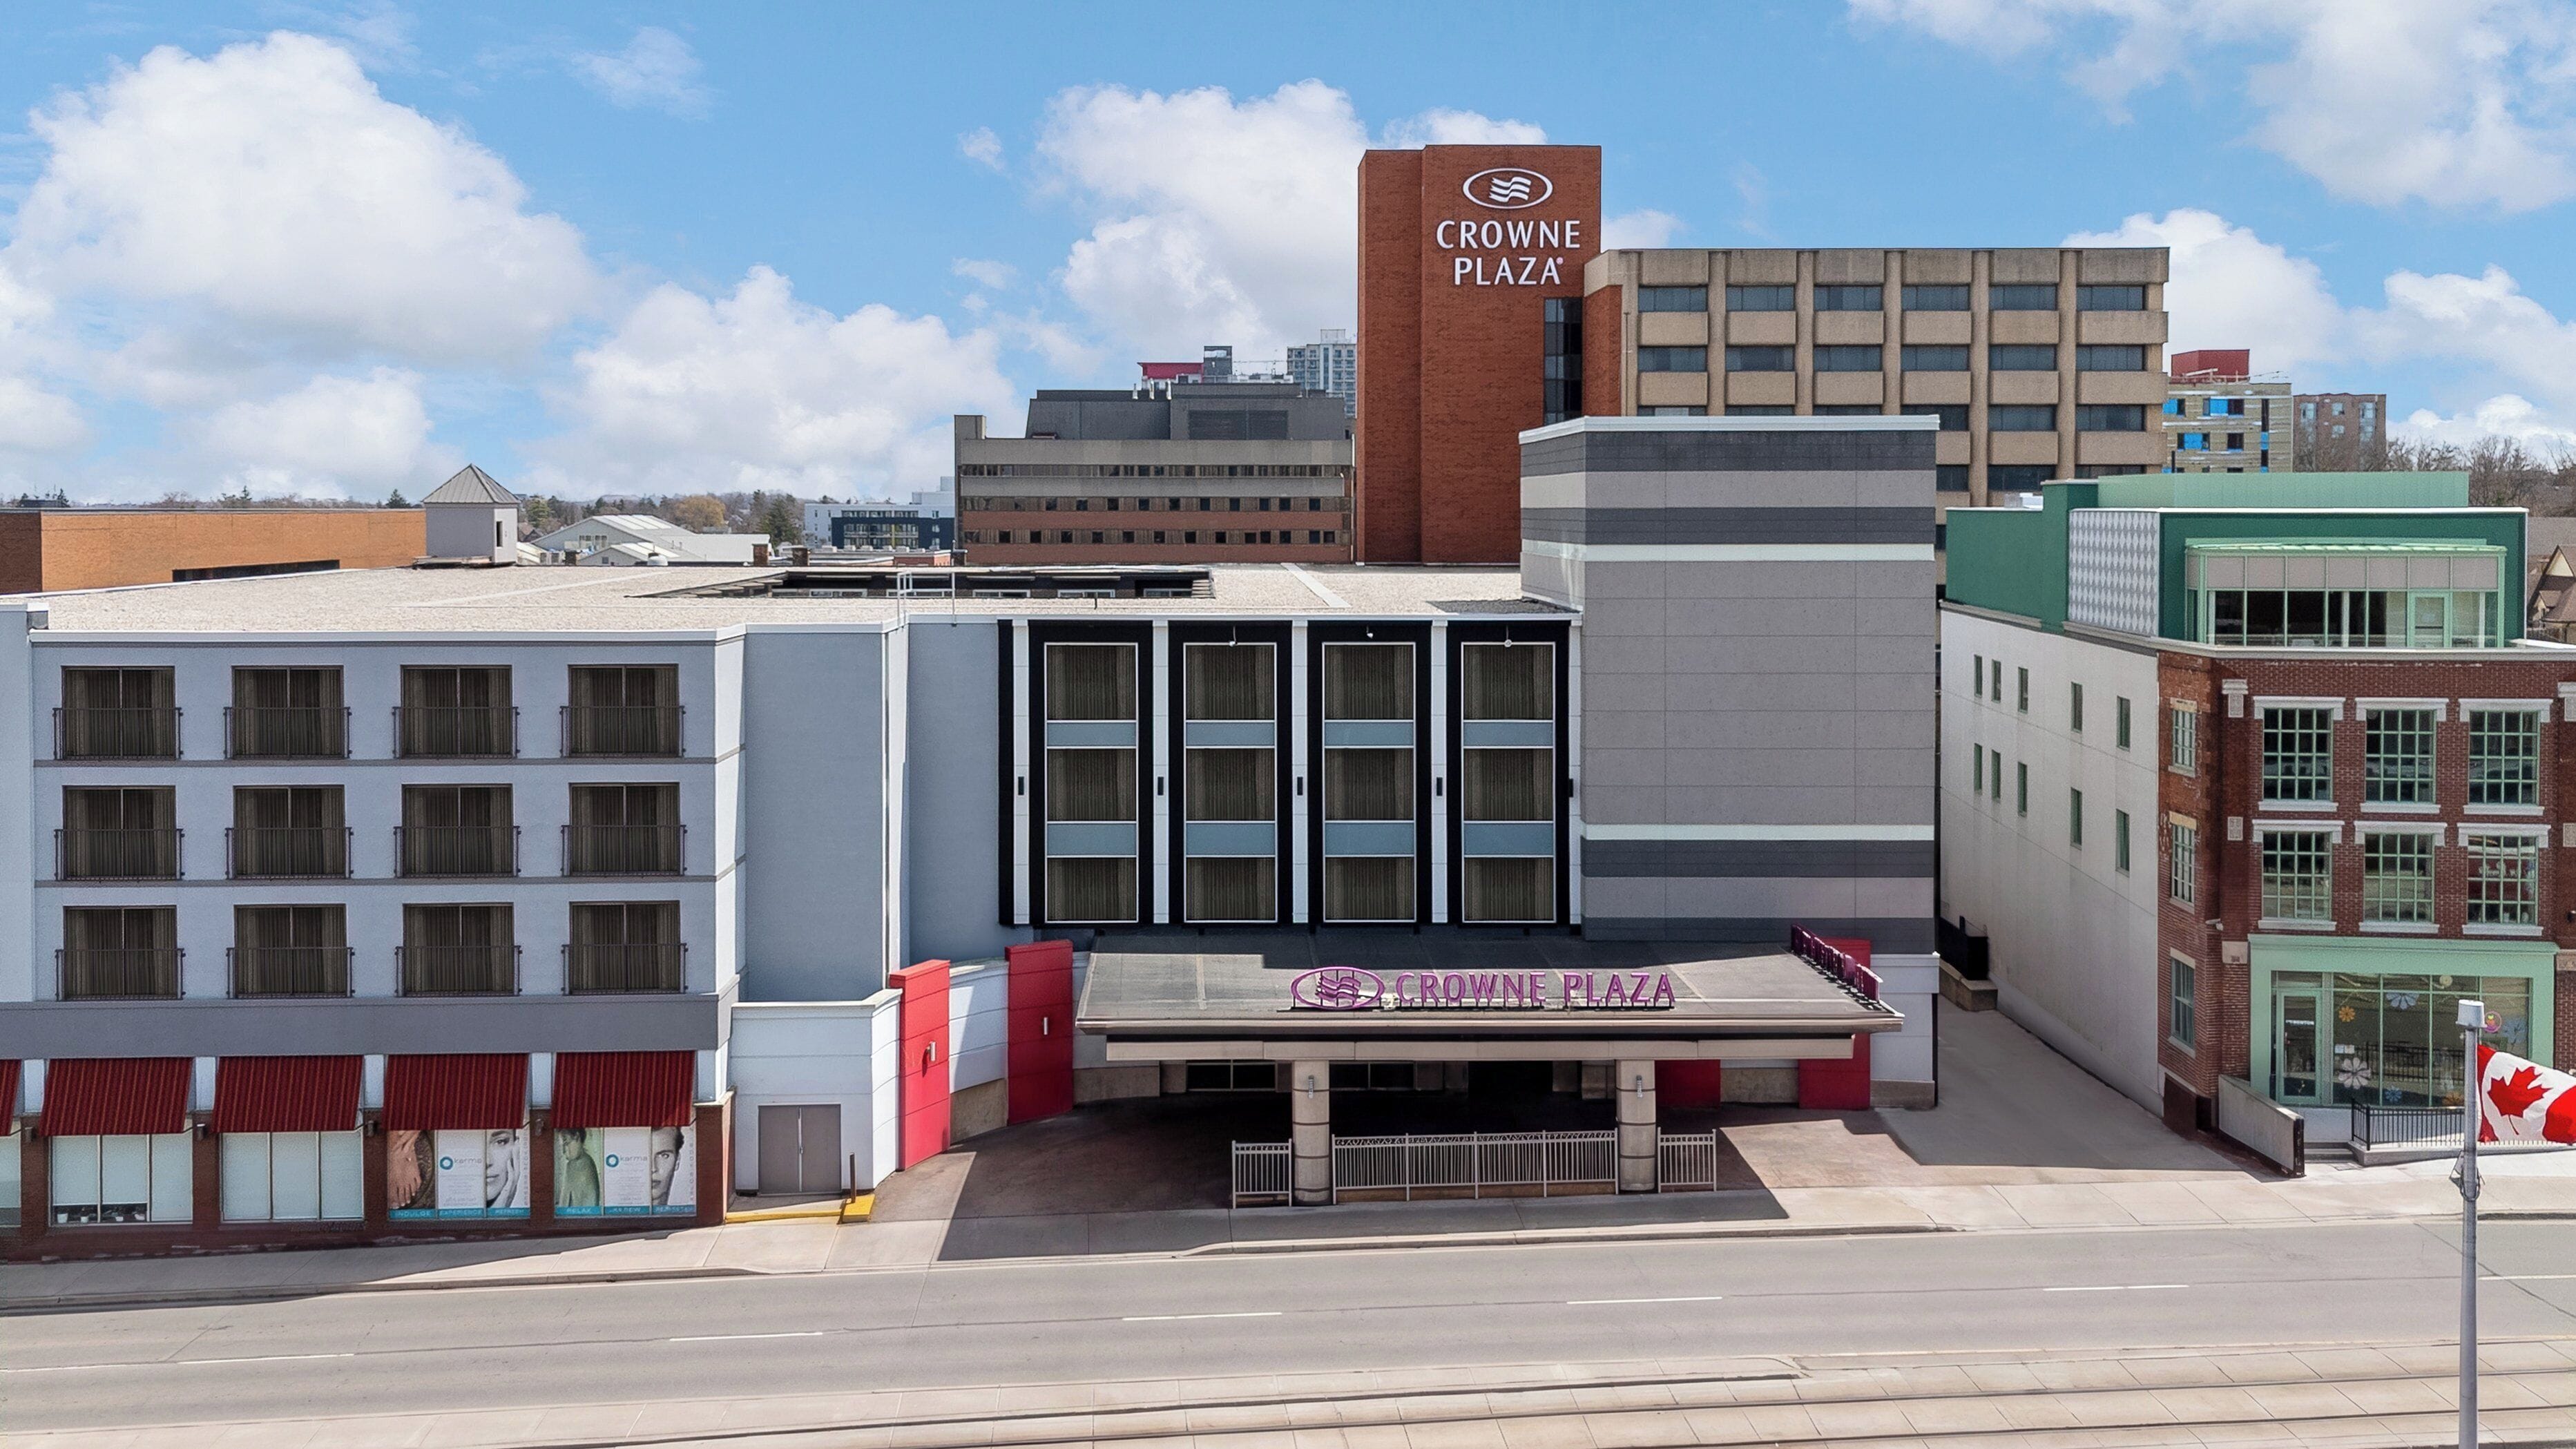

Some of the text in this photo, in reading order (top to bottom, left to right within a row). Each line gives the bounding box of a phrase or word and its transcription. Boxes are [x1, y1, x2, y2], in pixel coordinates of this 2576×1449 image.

[1436, 220, 1581, 249] CROWNE
[1396, 972, 1675, 1003] CROWNE PLAZA
